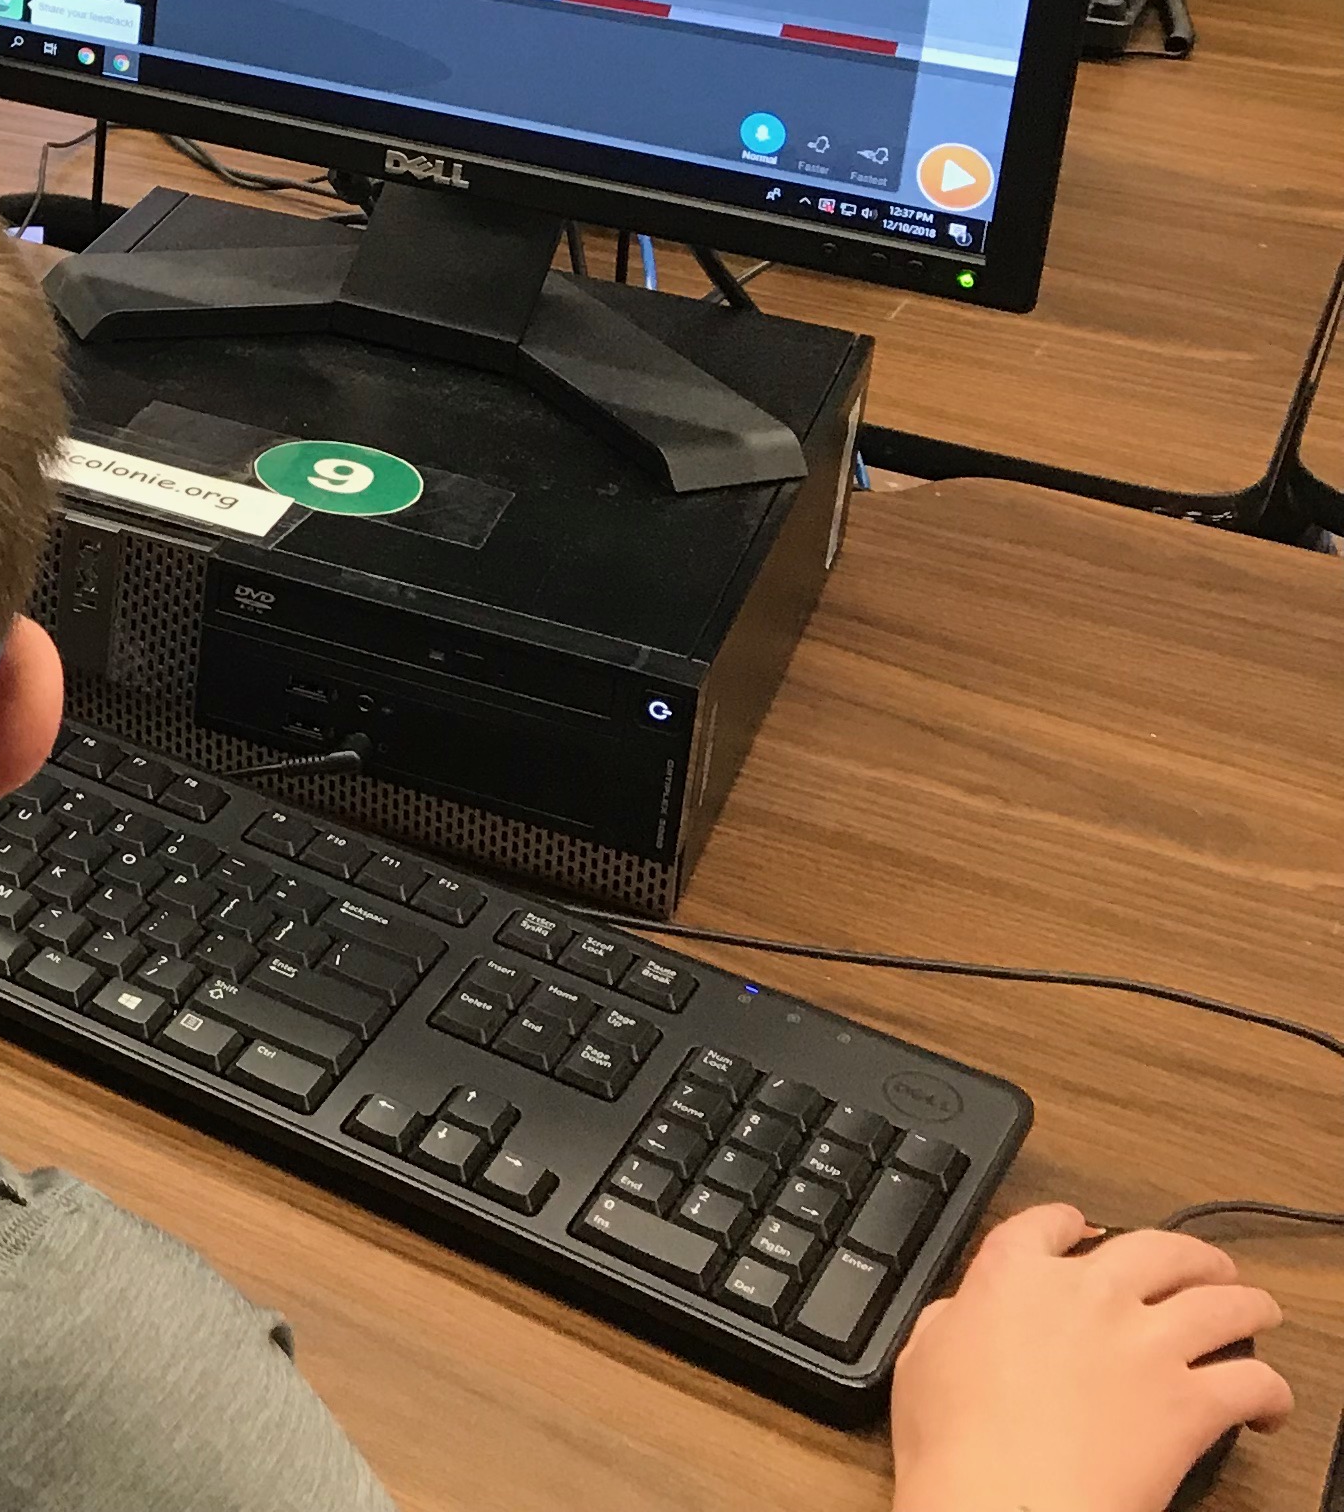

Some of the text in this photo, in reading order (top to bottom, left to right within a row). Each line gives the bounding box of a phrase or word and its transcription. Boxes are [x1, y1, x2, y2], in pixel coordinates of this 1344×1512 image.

[38, 1, 134, 28] Share your feedback!
[741, 149, 778, 166] Normal
[384, 149, 470, 189] DELL
[797, 159, 831, 176] Faster
[849, 170, 889, 187] Fastest
[889, 205, 934, 223] 12:37 PM
[882, 218, 937, 238] 12/10/2018
[307, 458, 375, 495] 9
[234, 584, 276, 604] DVD
[342, 900, 389, 925] Backspace
[581, 941, 605, 957] Lock
[586, 936, 614, 952] Scroll
[46, 952, 62, 964] Alt
[271, 958, 300, 974] Enter
[487, 960, 517, 977] Insert
[641, 968, 672, 985] Break
[648, 960, 677, 977] Pause
[215, 979, 239, 995] Shift
[548, 984, 578, 1003] Home
[460, 992, 493, 1011] Delete
[521, 1018, 543, 1033] End
[610, 1009, 637, 1026] Page
[257, 1045, 277, 1059] Ctrl
[580, 1049, 612, 1068] Down
[585, 1044, 611, 1061] Page
[707, 1049, 733, 1066] Num
[702, 1056, 728, 1072] Lock
[672, 1100, 705, 1119] Home
[809, 1157, 841, 1176] PgUp
[620, 1175, 643, 1192] End
[593, 1215, 611, 1228] Ins
[760, 1237, 791, 1257] PgDn
[841, 1253, 875, 1273] Enter
[733, 1279, 755, 1295] Del
